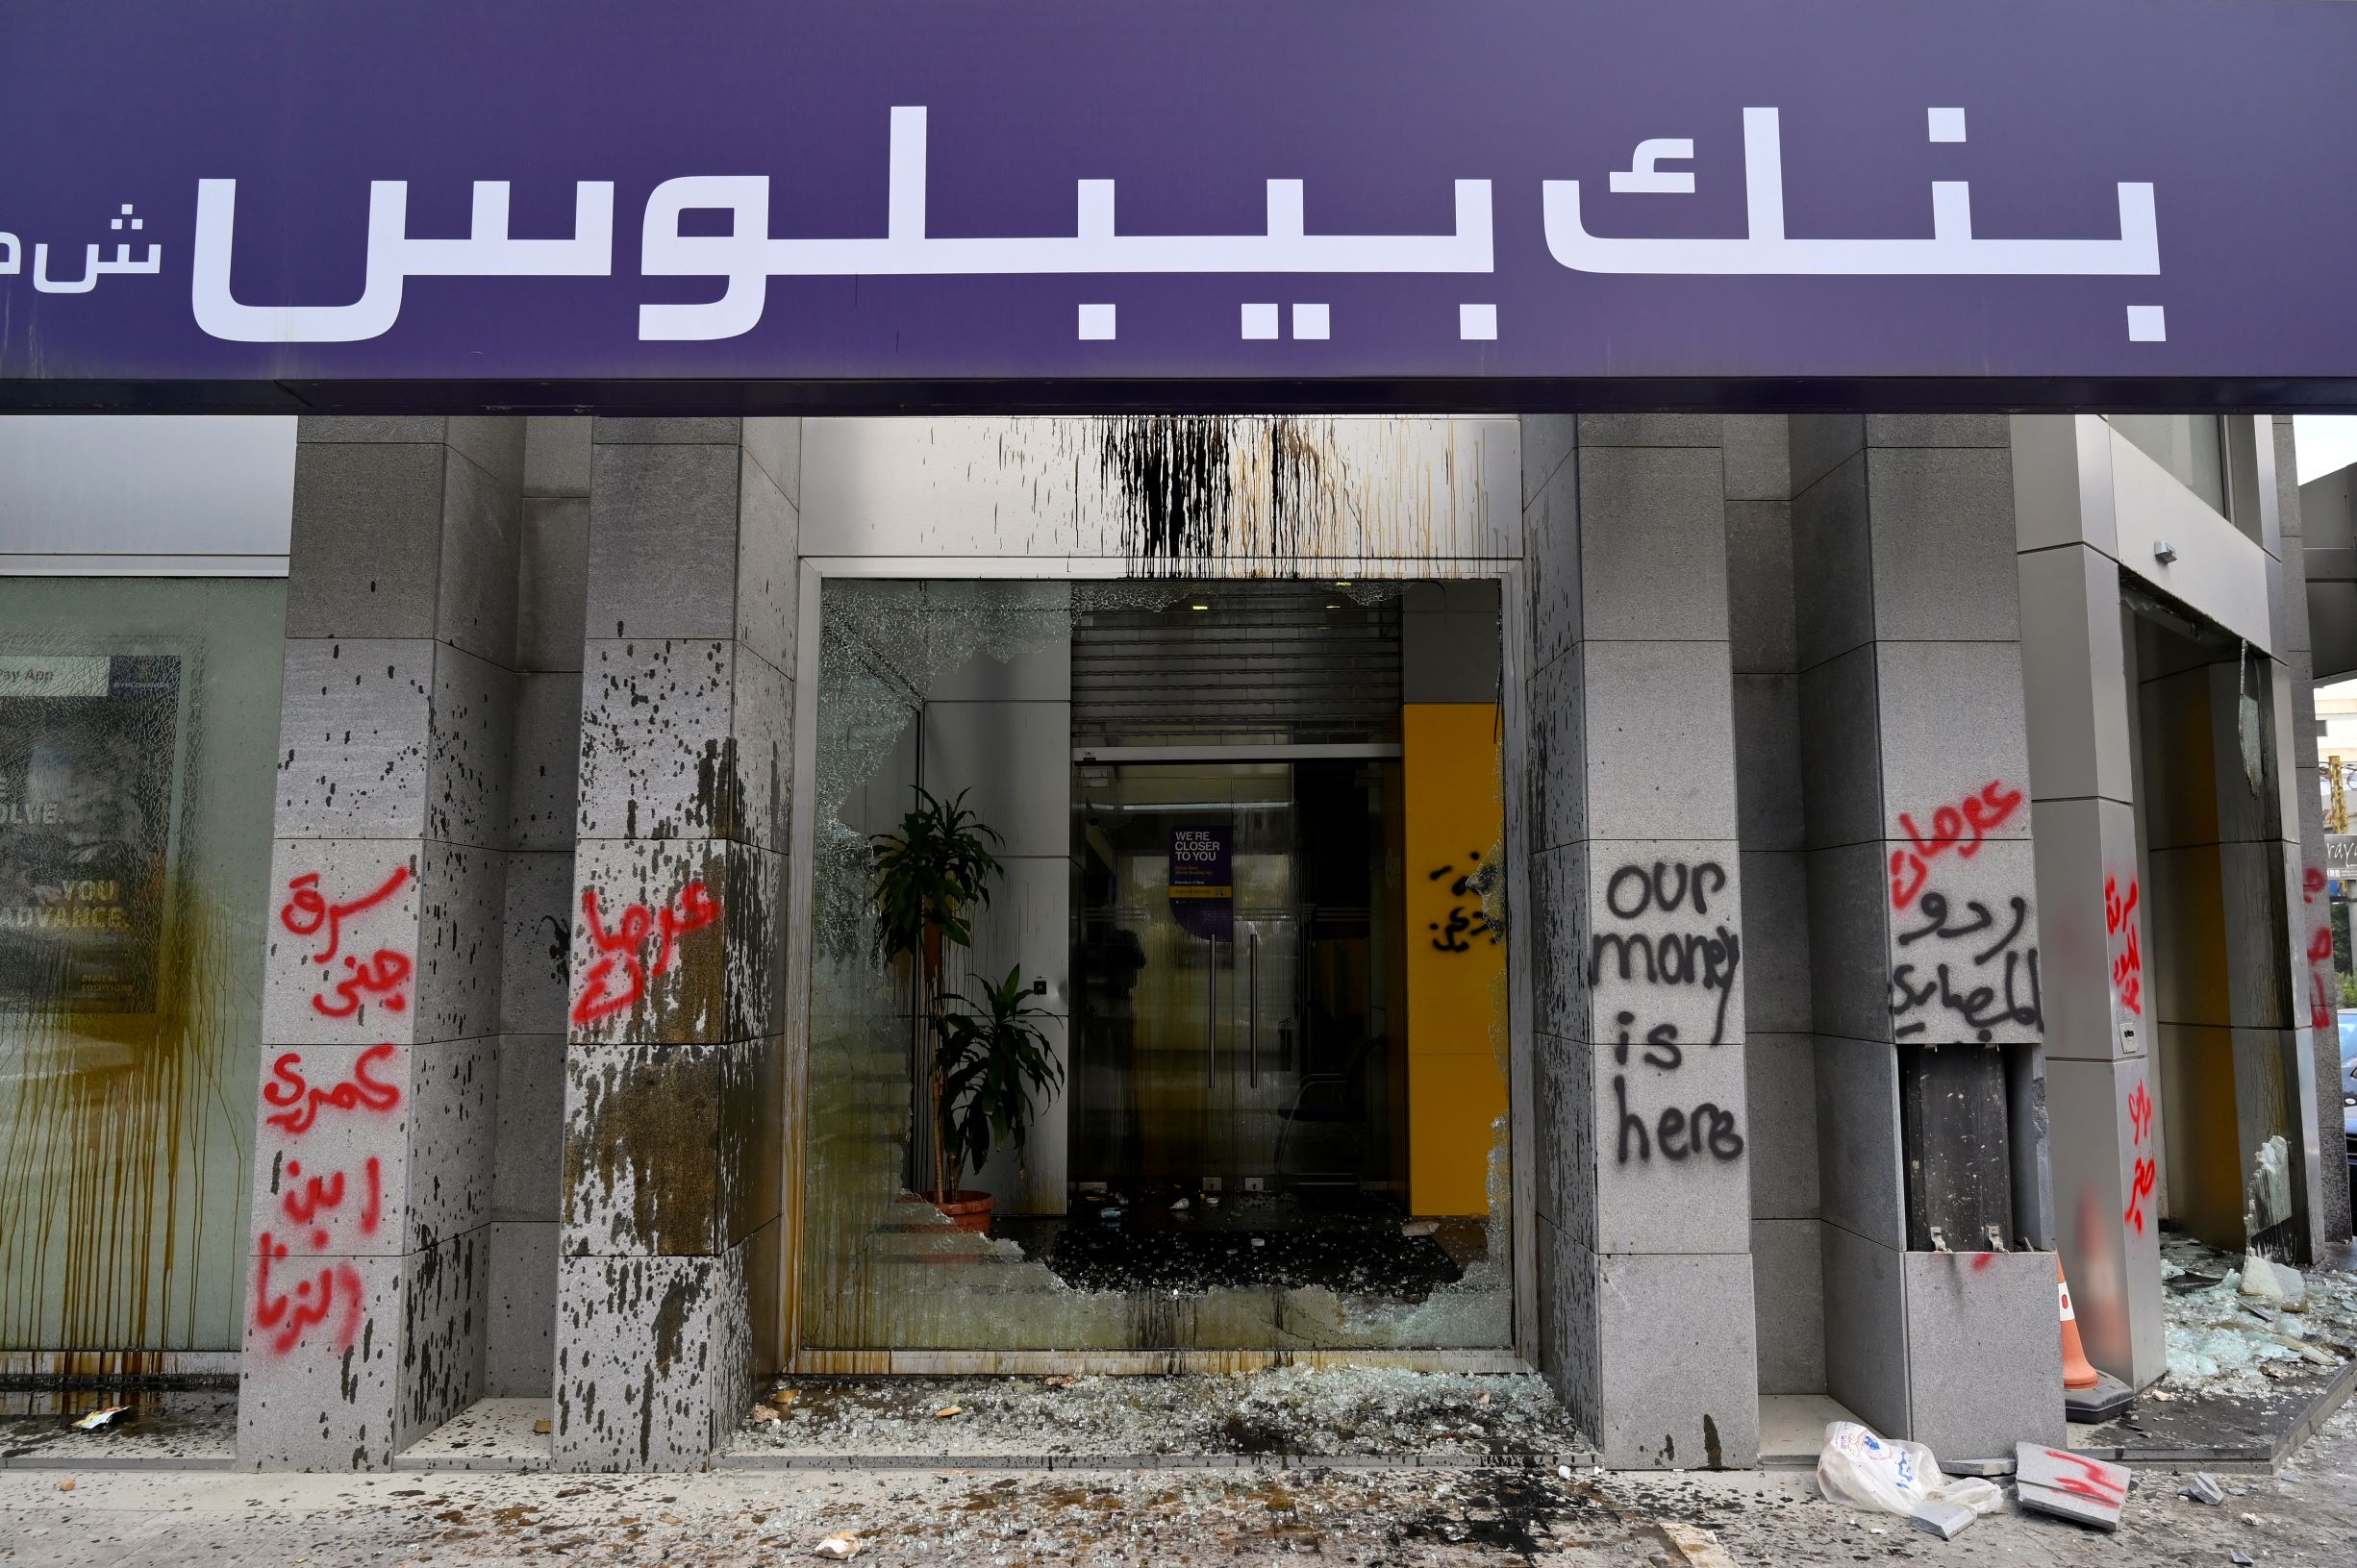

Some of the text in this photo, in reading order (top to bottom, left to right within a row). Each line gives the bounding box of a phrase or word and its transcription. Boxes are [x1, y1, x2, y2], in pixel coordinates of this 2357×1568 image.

[34, 204, 162, 294] ش
[192, 103, 1497, 343] بيبلوس
[1542, 107, 2166, 342] بنك
[1174, 841, 1220, 852] CLOSER
[1175, 831, 1210, 841] WE'RE
[1175, 851, 1216, 861] TO YOU
[62, 880, 116, 902] YOU
[1591, 926, 1741, 1046] money
[1616, 1011, 1683, 1070] is
[1614, 1074, 1744, 1164] here
